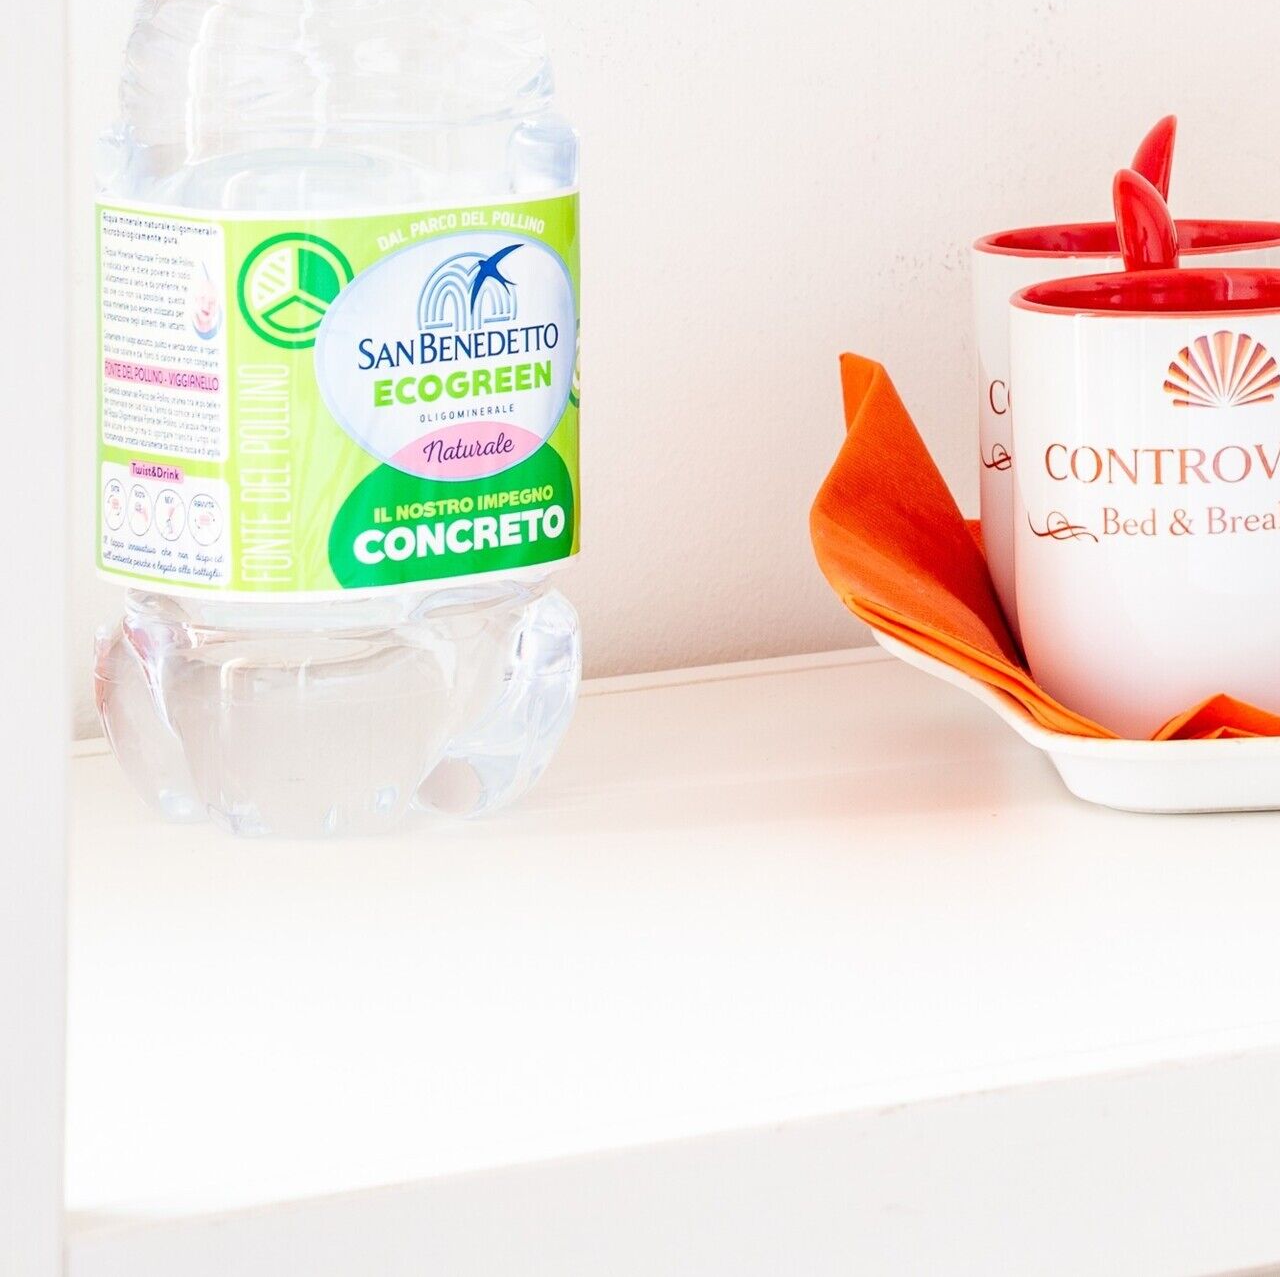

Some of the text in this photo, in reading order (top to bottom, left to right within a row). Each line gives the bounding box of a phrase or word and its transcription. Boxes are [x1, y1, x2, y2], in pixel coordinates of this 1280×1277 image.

[376, 210, 546, 252] DAL PARCO DEL POLLINO
[358, 322, 559, 370] SAN BENEDETTO
[373, 360, 552, 407] ECOGREEN
[419, 403, 515, 423] OLIGOMINERALE
[422, 432, 515, 463] Naturale
[131, 462, 180, 481] Twist&Drink
[239, 363, 293, 582] FONTE DEL POLLINO
[373, 485, 553, 523] IL NOSTRO IMPEGNO
[1102, 505, 1158, 538] Bed
[1168, 508, 1194, 536] &
[352, 504, 566, 565] CONCRETO
